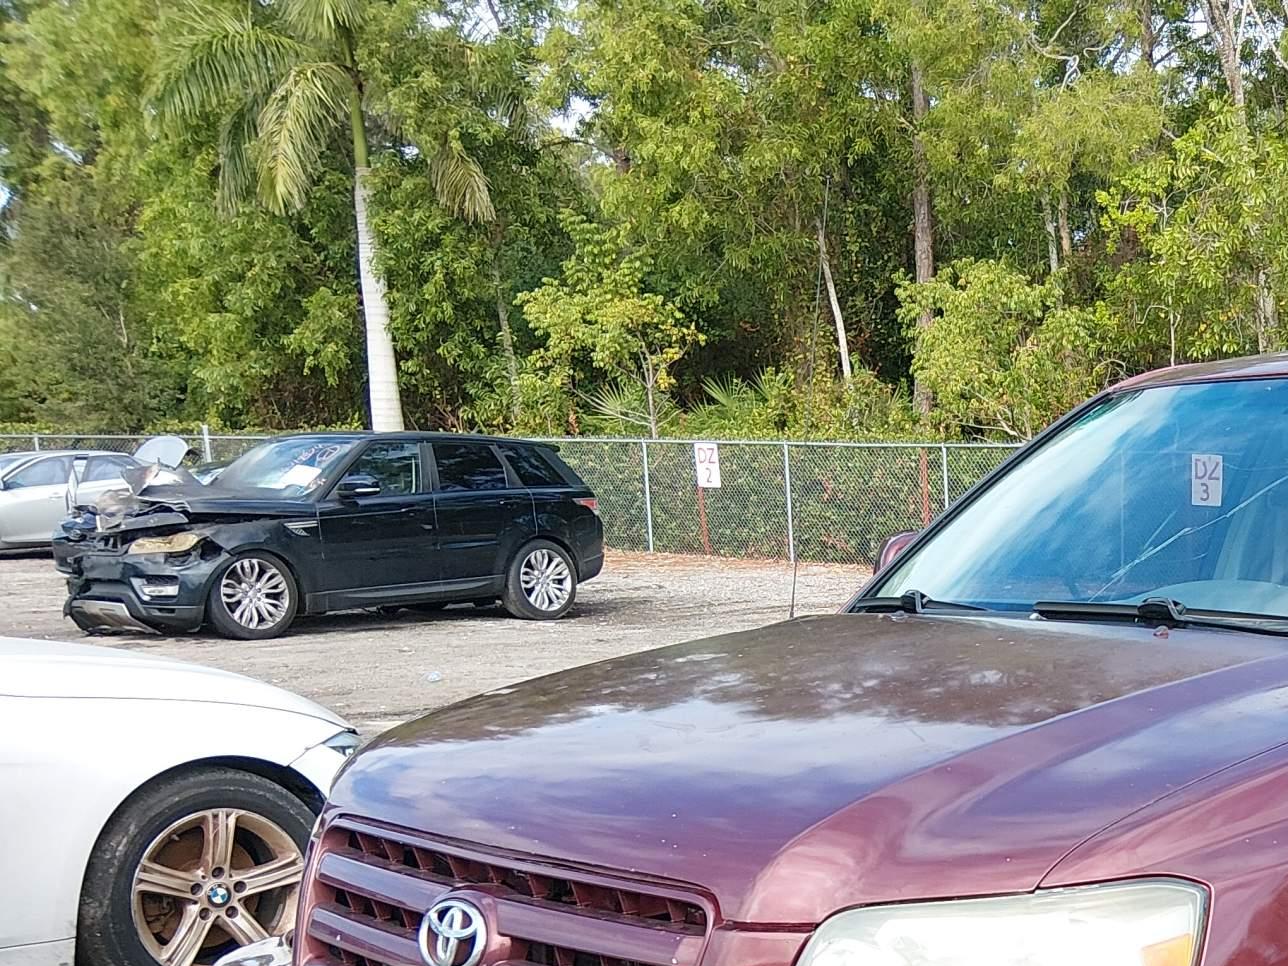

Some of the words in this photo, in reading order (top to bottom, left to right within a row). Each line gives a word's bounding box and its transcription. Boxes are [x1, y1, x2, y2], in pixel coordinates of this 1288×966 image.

[697, 447, 717, 464] DZ
[705, 467, 713, 483] 2
[1199, 482, 1210, 502] 3
